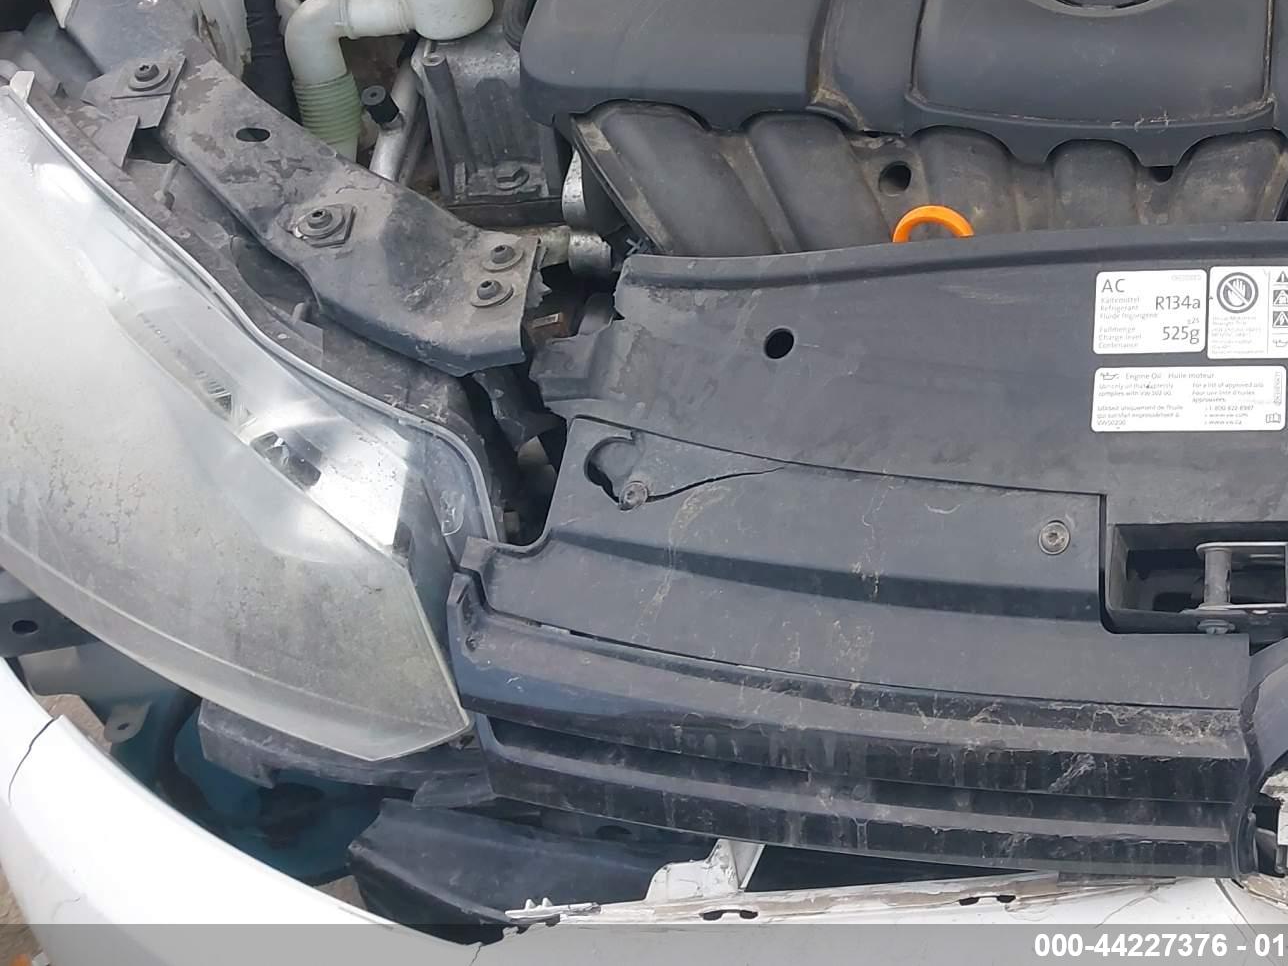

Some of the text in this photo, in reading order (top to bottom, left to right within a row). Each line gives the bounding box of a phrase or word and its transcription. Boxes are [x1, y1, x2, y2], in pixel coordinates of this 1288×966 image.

[1101, 278, 1126, 293] AC
[1155, 295, 1201, 311] R134a
[1161, 325, 1201, 345] 525g
[1125, 372, 1150, 381] Engine
[1168, 371, 1187, 379] Huile
